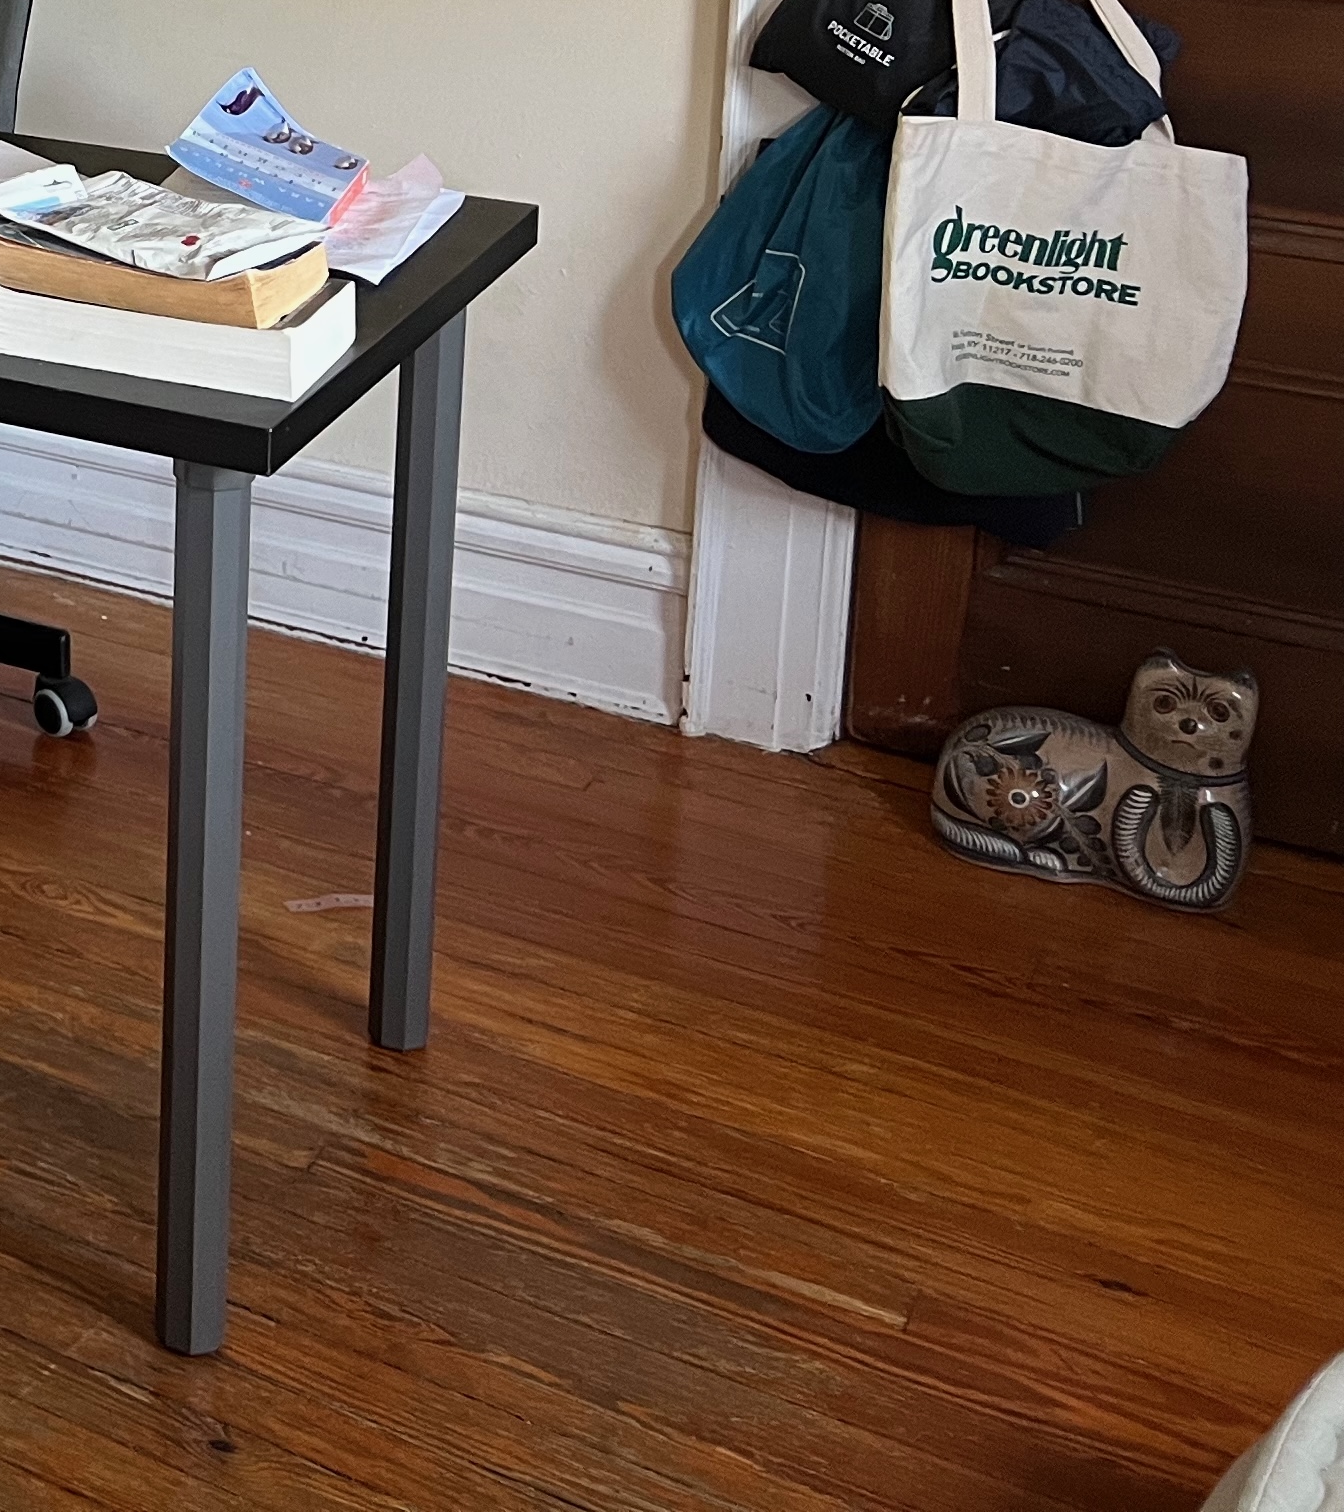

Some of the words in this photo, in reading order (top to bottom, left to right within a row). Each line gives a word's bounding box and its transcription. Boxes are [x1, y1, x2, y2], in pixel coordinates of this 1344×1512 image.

[827, 20, 895, 67] POCKETABLE
[931, 204, 1129, 284] greenlight
[951, 260, 1141, 307] BOOKSTORE
[982, 343, 1011, 356] 11217
[985, 333, 1015, 347] Street
